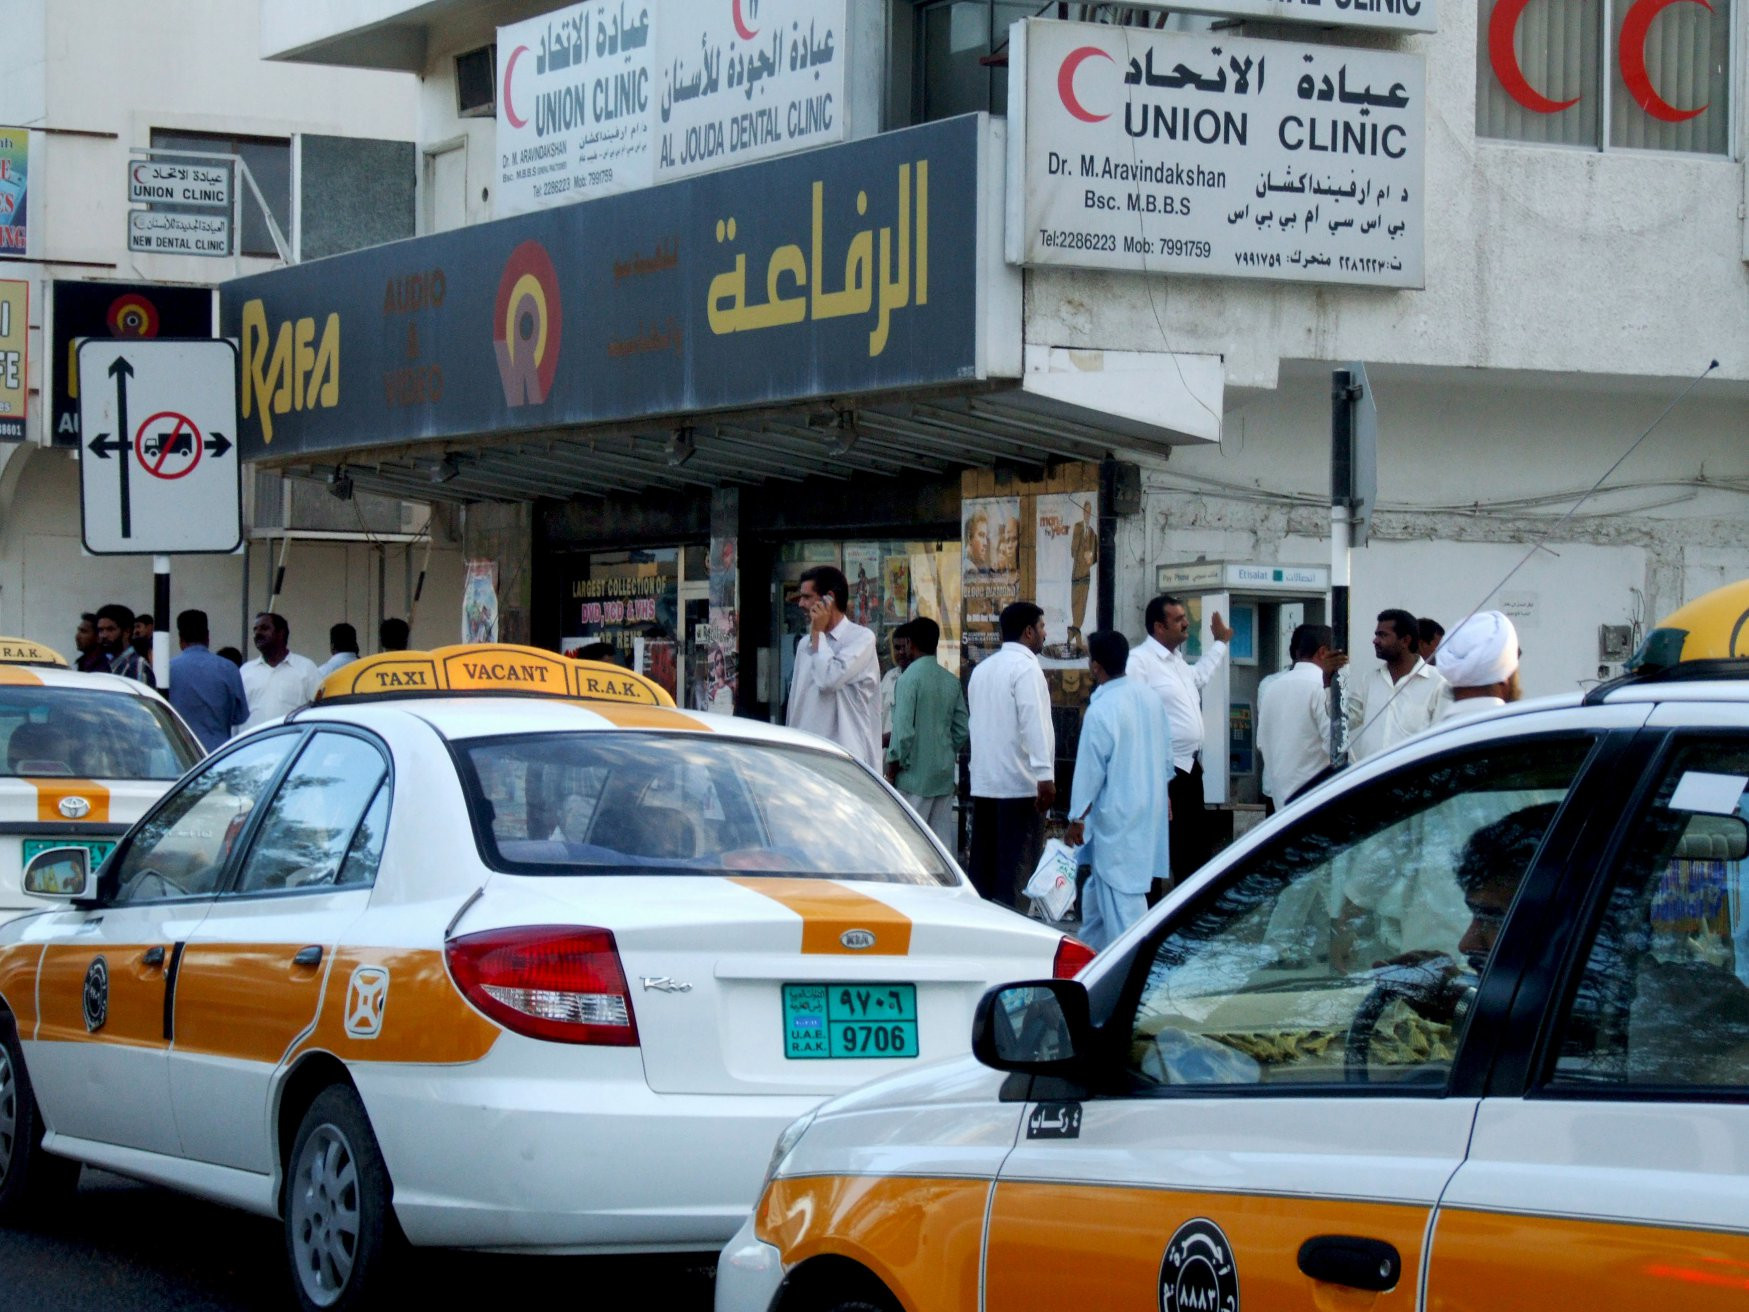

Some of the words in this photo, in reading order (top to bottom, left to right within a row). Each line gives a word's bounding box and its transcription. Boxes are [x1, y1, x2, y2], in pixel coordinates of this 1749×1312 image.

[537, 9, 589, 75] الاتحاد
[596, 0, 649, 63] عيادة
[728, 26, 783, 100] الجودة
[1124, 46, 1265, 96] الاتحاد
[1297, 54, 1410, 117] عيادة
[536, 82, 585, 137] UNION
[593, 66, 649, 123] CLINIC
[660, 133, 675, 169] AL
[681, 121, 724, 165] JOUDA
[730, 106, 782, 152] DENTAL
[787, 92, 833, 139] CLINIC
[1124, 102, 1248, 146] UNION
[1279, 115, 1407, 159] CLINIC
[152, 167, 188, 181] الاتحاد
[1048, 152, 1072, 175] Dr.
[193, 170, 222, 186] عيادة
[544, 178, 571, 195] 2286223
[134, 185, 174, 198] UNION
[183, 188, 224, 202] CLINIC
[1084, 190, 1120, 211] Bsc.
[1127, 193, 1191, 216] M.B.B.S
[133, 236, 152, 247] NEW
[156, 237, 191, 249] DENTAL
[195, 239, 225, 251] CLINIC
[1124, 236, 1154, 254] Mob:
[1159, 238, 1211, 258] 7991759
[383, 267, 447, 317] AUDIO
[1239, 569, 1267, 580] Etisalat
[572, 580, 606, 598] LARGEST
[607, 576, 655, 597] COLLECTION
[656, 575, 667, 594] OF
[635, 598, 655, 620] VHS
[4, 648, 42, 659] R.A.K.
[375, 671, 427, 687] TAXI
[463, 663, 549, 683] VACANT
[587, 678, 641, 698] R.A.K.
[840, 989, 903, 1016] ٩٧٠٦
[791, 1030, 826, 1039] U.A.E.
[843, 1025, 905, 1052] 9706
[792, 1042, 827, 1051] R.A.K.
